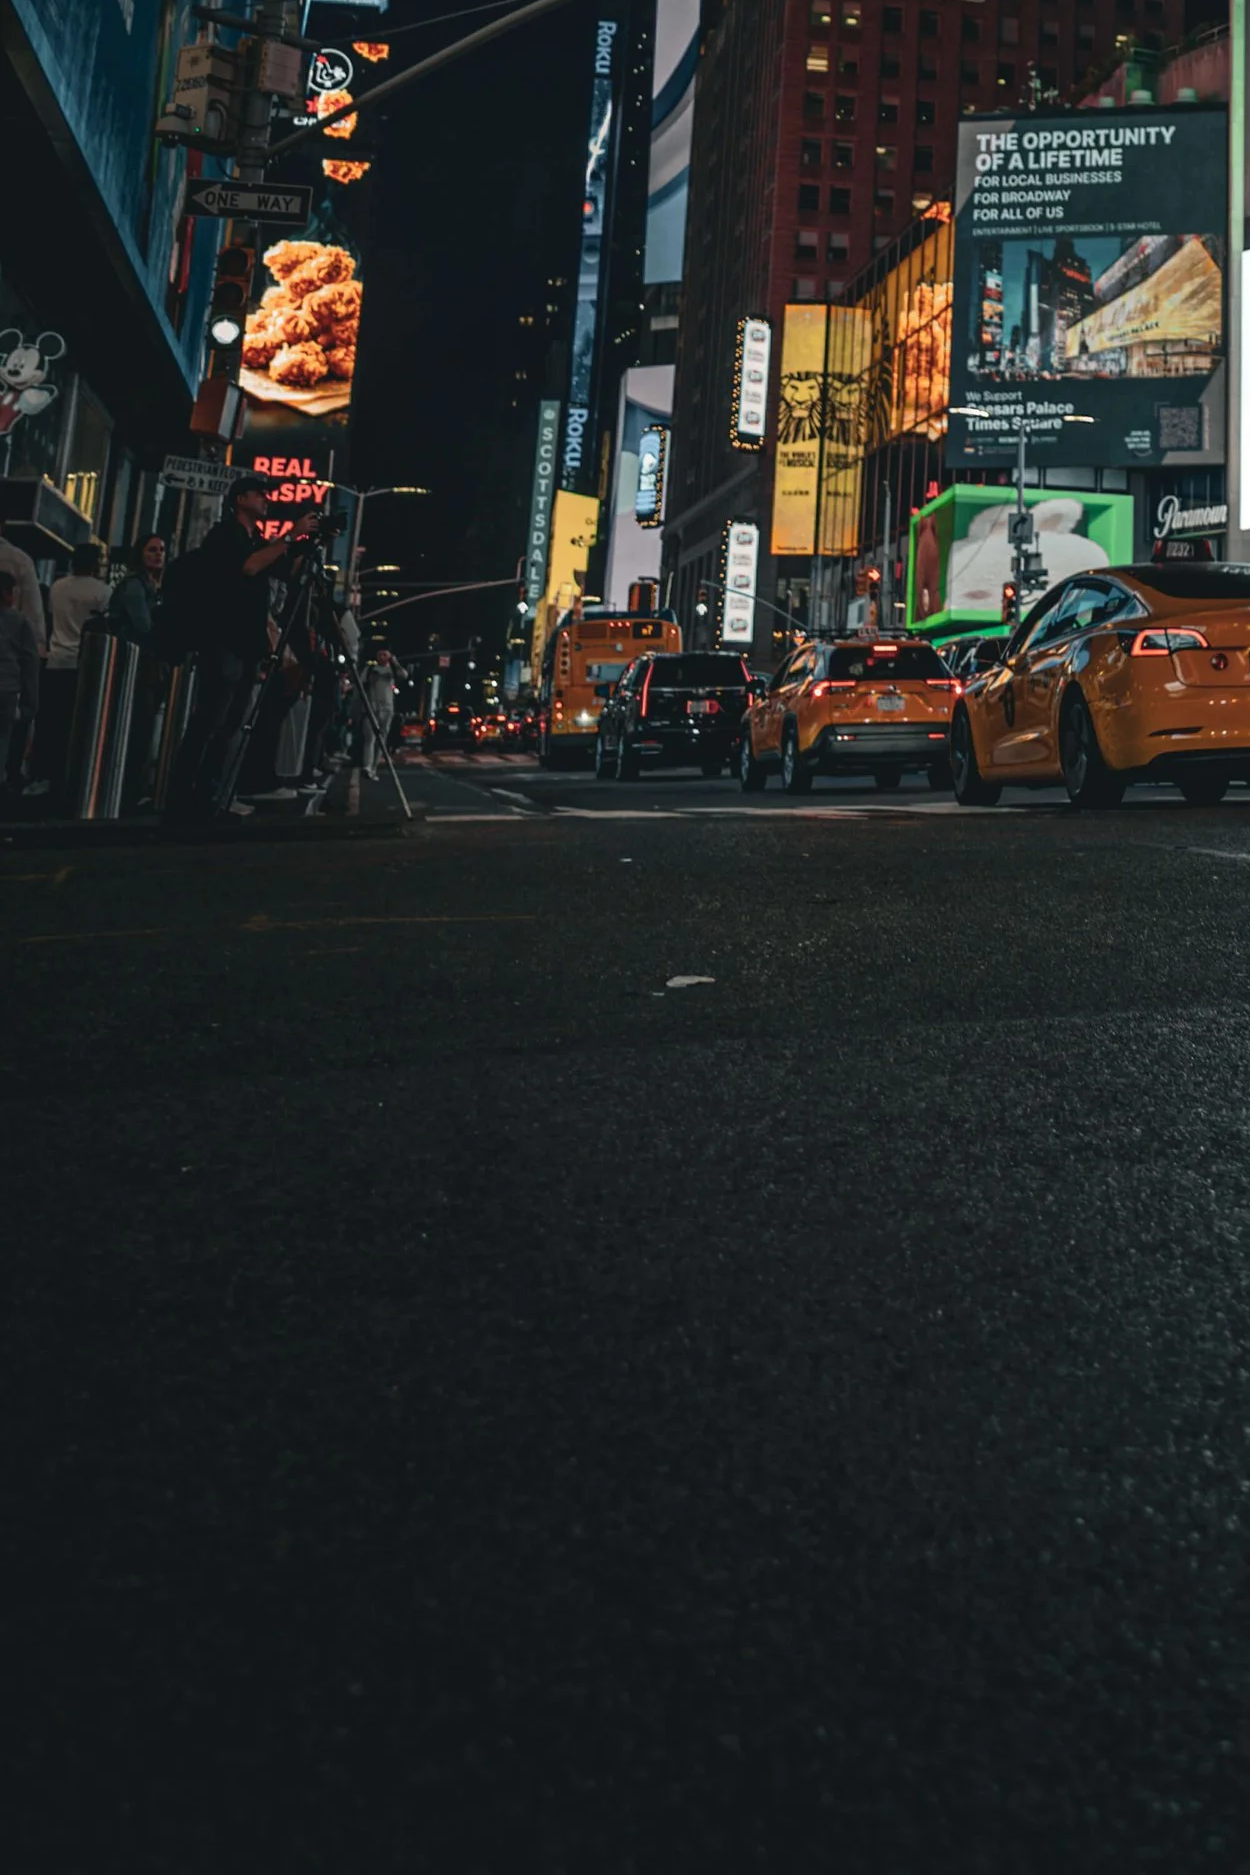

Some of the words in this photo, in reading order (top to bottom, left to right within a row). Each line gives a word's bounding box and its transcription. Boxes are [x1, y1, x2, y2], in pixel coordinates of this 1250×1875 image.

[976, 132, 1019, 153] THE
[1022, 125, 1176, 150] OPPORTUNITY
[975, 152, 1004, 172] OF
[1007, 151, 1024, 171] A
[1027, 147, 1124, 170] LIFETIME
[974, 175, 1000, 188] FOR
[1001, 173, 1043, 188] LOCAL
[1045, 170, 1123, 186] BUSINESSES
[204, 189, 239, 208] ONE
[256, 194, 295, 212] WAY
[973, 192, 1000, 205] FOR
[1001, 189, 1072, 204] BROADWAY
[972, 208, 999, 221] FOR
[1000, 207, 1024, 221] ALL
[1025, 207, 1045, 220] OF
[1045, 206, 1065, 219] US
[972, 226, 1032, 236] ENTERTAINMENT
[965, 390, 982, 402] We
[983, 390, 1023, 404] Support
[1026, 401, 1075, 415] Palace
[966, 417, 1010, 431] Times
[1011, 416, 1063, 433] Square
[253, 455, 318, 479] REAL
[527, 423, 555, 600] SCOTTSDALE
